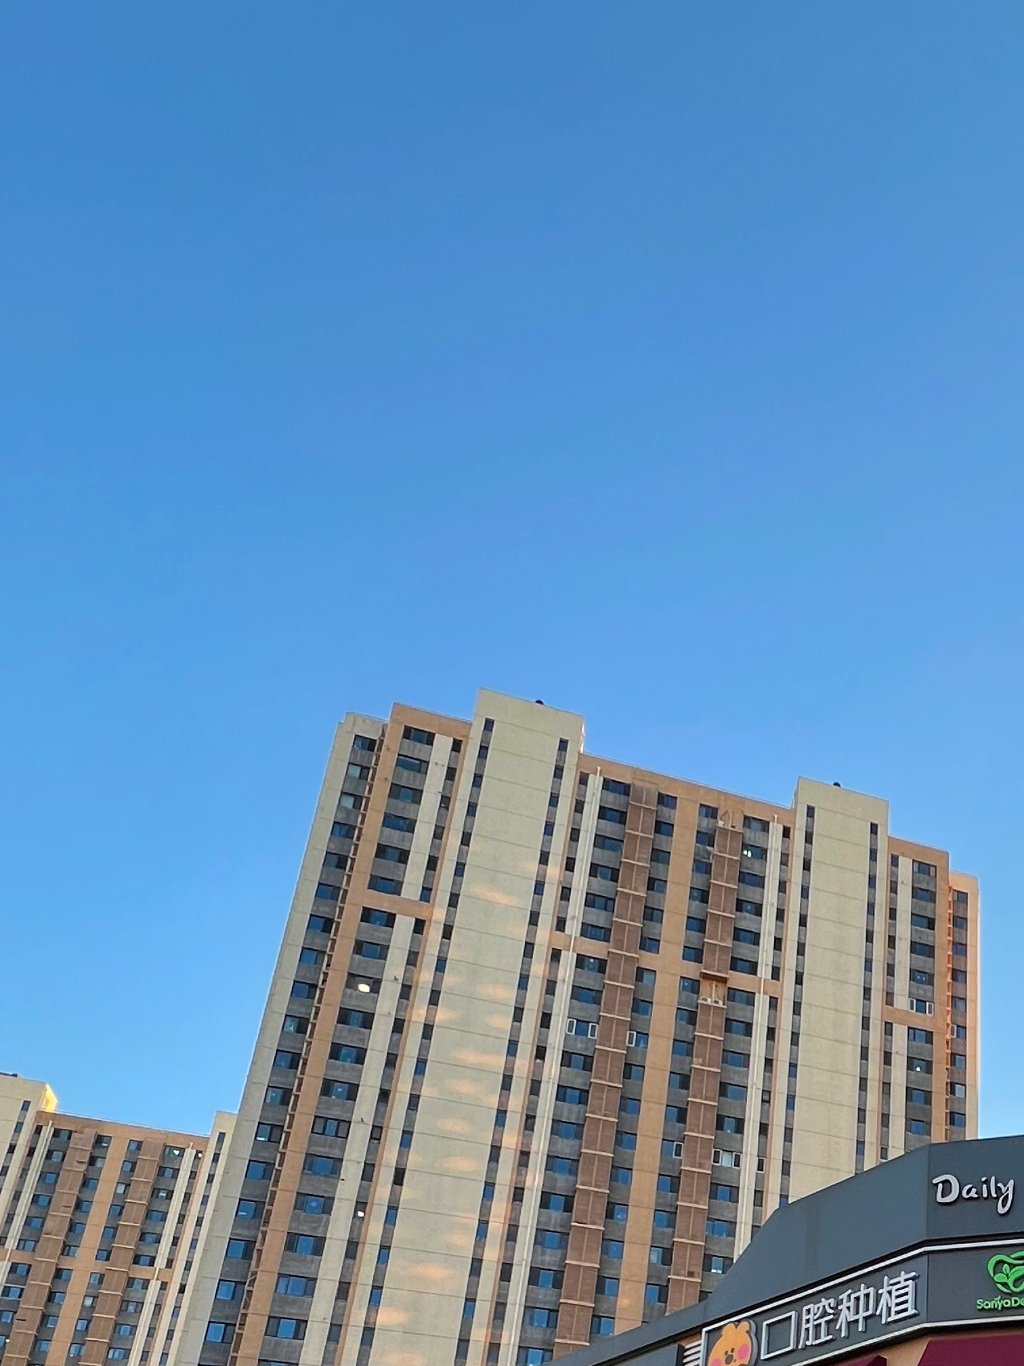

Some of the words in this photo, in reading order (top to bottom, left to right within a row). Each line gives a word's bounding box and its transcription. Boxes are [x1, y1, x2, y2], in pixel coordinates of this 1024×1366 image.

[932, 1174, 1015, 1215] Daily
[761, 1271, 919, 1359] 口腔种植
